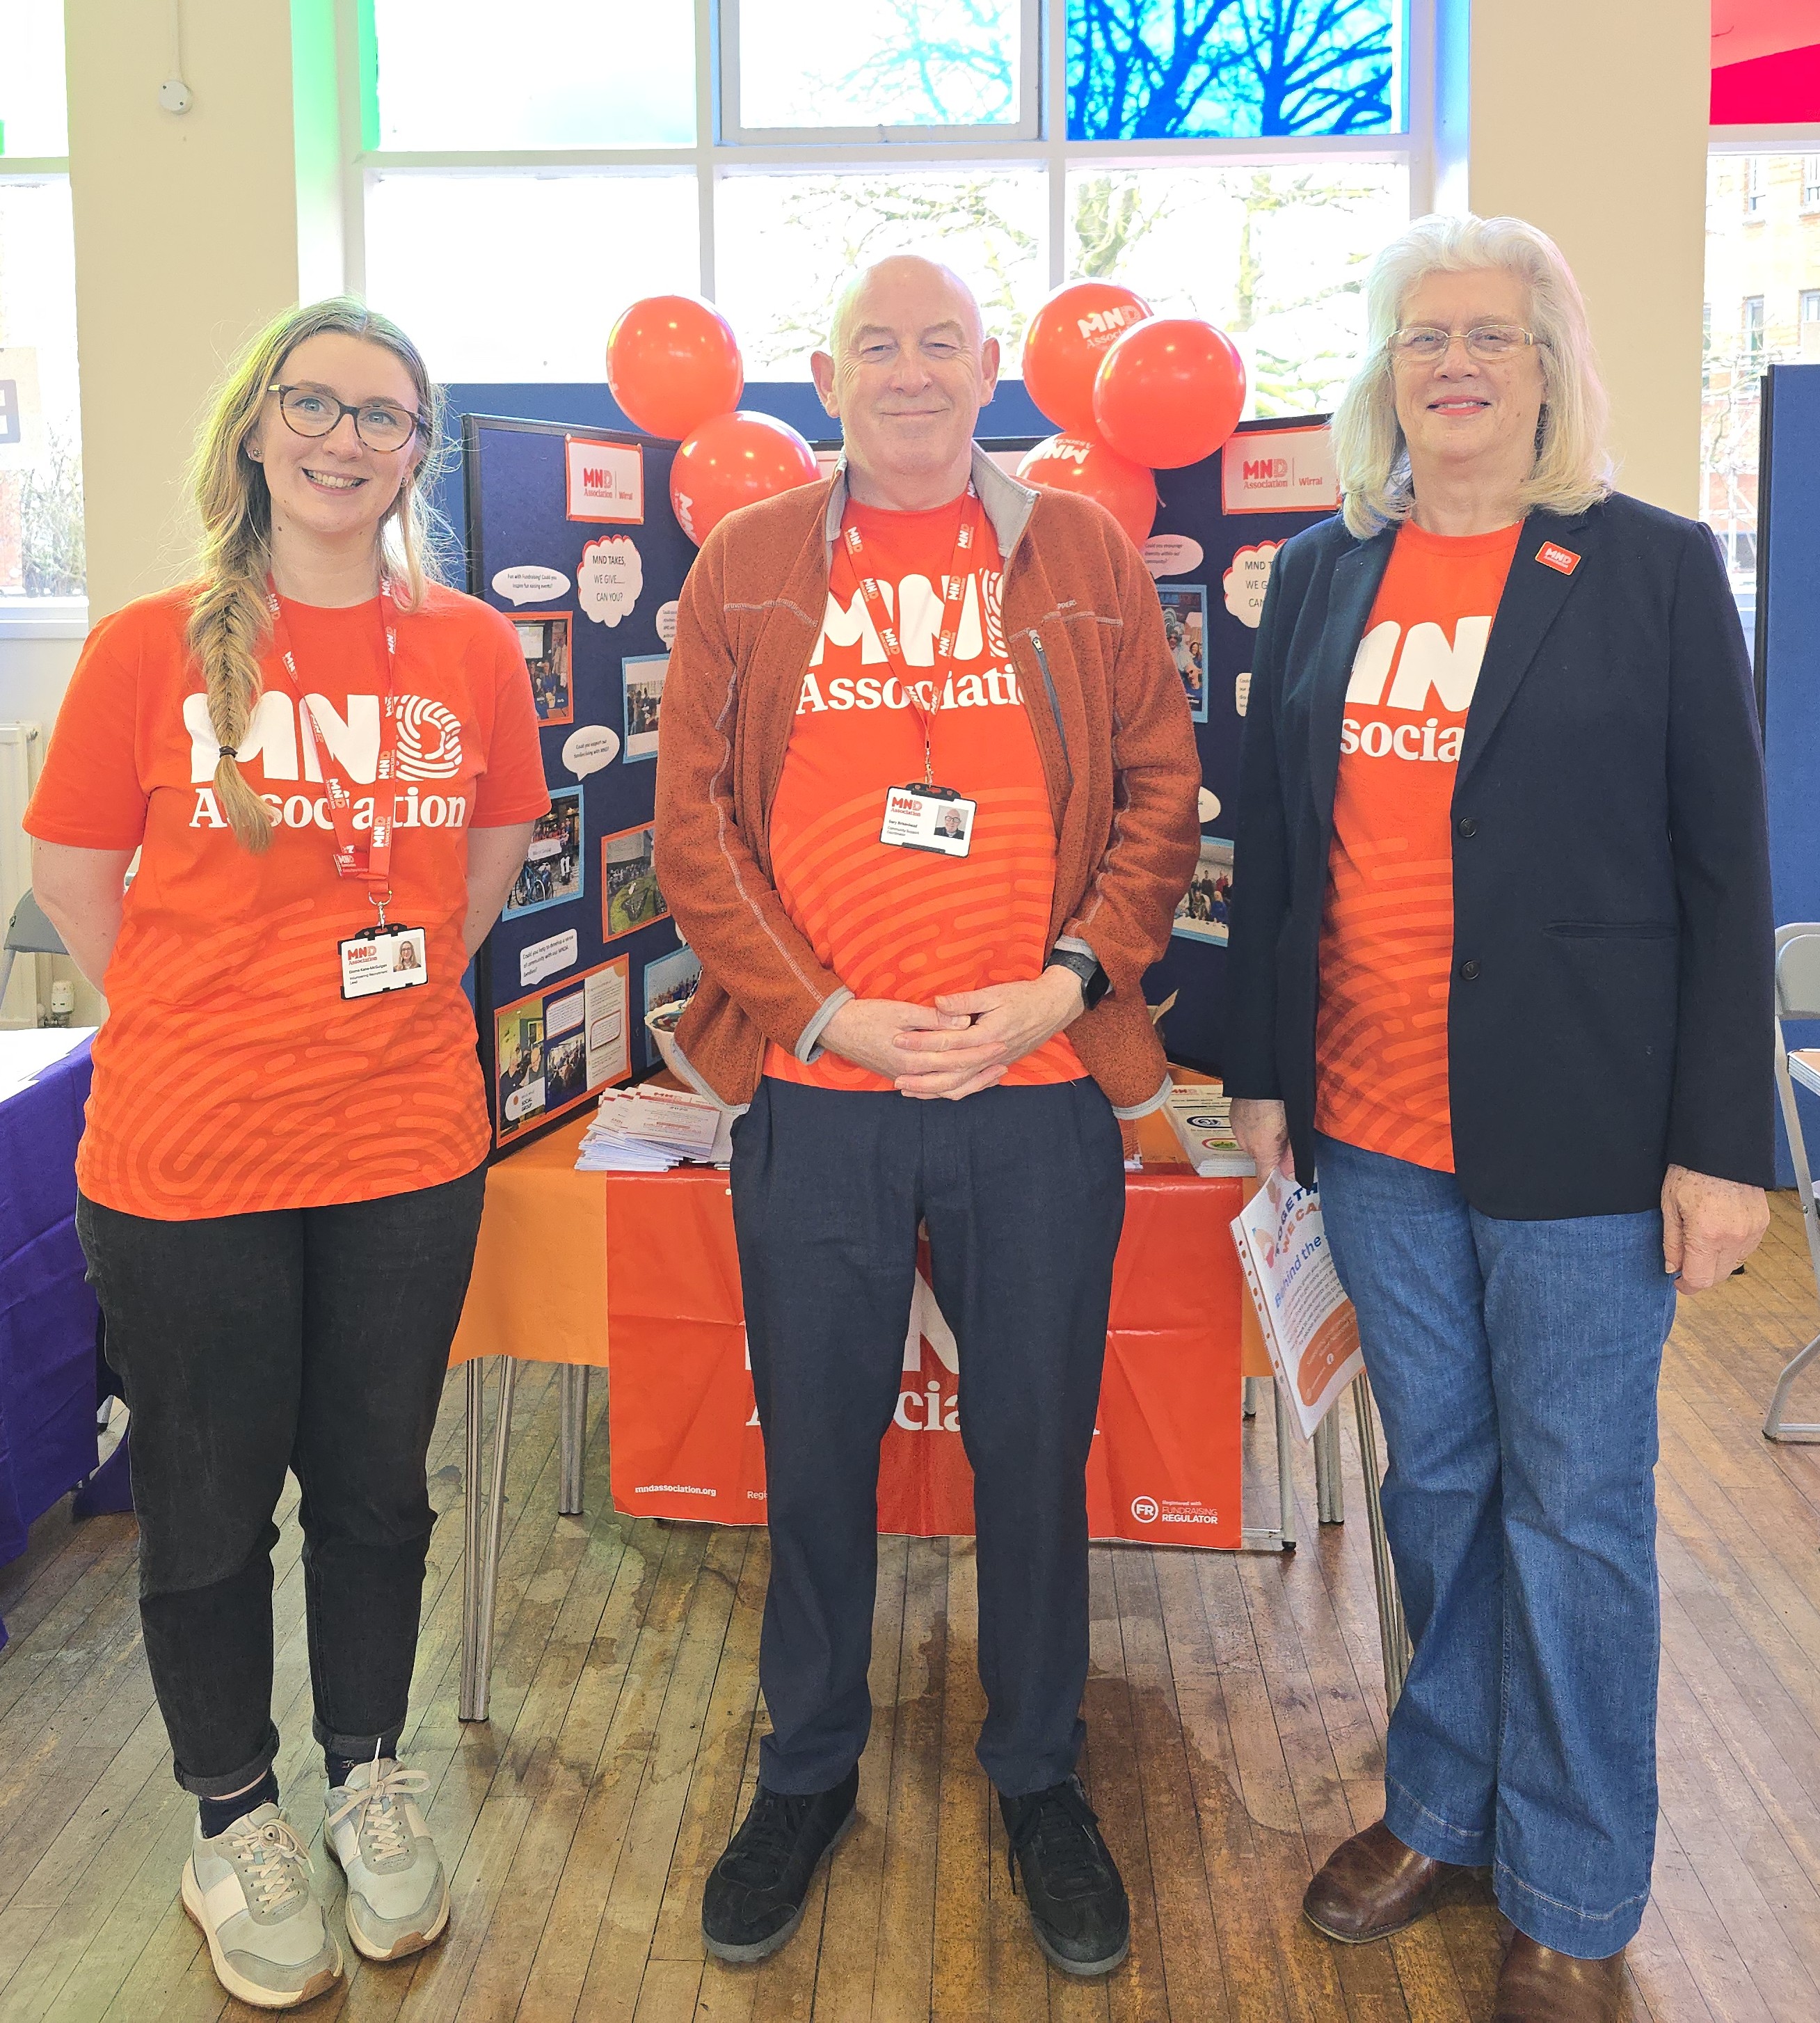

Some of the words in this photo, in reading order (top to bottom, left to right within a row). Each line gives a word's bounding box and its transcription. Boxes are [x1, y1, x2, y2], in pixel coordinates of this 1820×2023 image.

[1077, 305, 1141, 339] MND
[1243, 459, 1288, 480] MND
[584, 468, 613, 489] MND
[1243, 479, 1288, 490] Association
[1298, 477, 1323, 486] Wirral
[584, 488, 613, 499] Association
[848, 526, 863, 553] MND
[957, 523, 970, 548] MND
[593, 555, 607, 564] MND
[608, 556, 626, 566] TAKES,
[1544, 548, 1572, 564] MND
[1245, 561, 1266, 570] MND
[594, 575, 603, 584] WE
[1246, 580, 1261, 589] WE
[863, 578, 879, 600] MND
[948, 576, 961, 601] MND
[596, 592, 608, 601] CAN
[609, 592, 623, 602] YOU?
[882, 628, 900, 655] MND
[938, 629, 952, 657] MND
[795, 664, 1025, 715] Associati
[183, 690, 463, 785] MND
[378, 750, 391, 779] MND
[329, 778, 346, 808] MND
[891, 797, 923, 811] MND
[891, 807, 921, 817] Association
[372, 816, 386, 848] MND
[348, 945, 377, 960] MND
[349, 956, 378, 966] Association
[1300, 1236, 1322, 1260] the
[634, 1484, 717, 1497] mndassociation.org
[1136, 1503, 1154, 1516] FR
[1162, 1506, 1218, 1516] FUNDRAISING
[1161, 1514, 1218, 1525] REGULATOR
